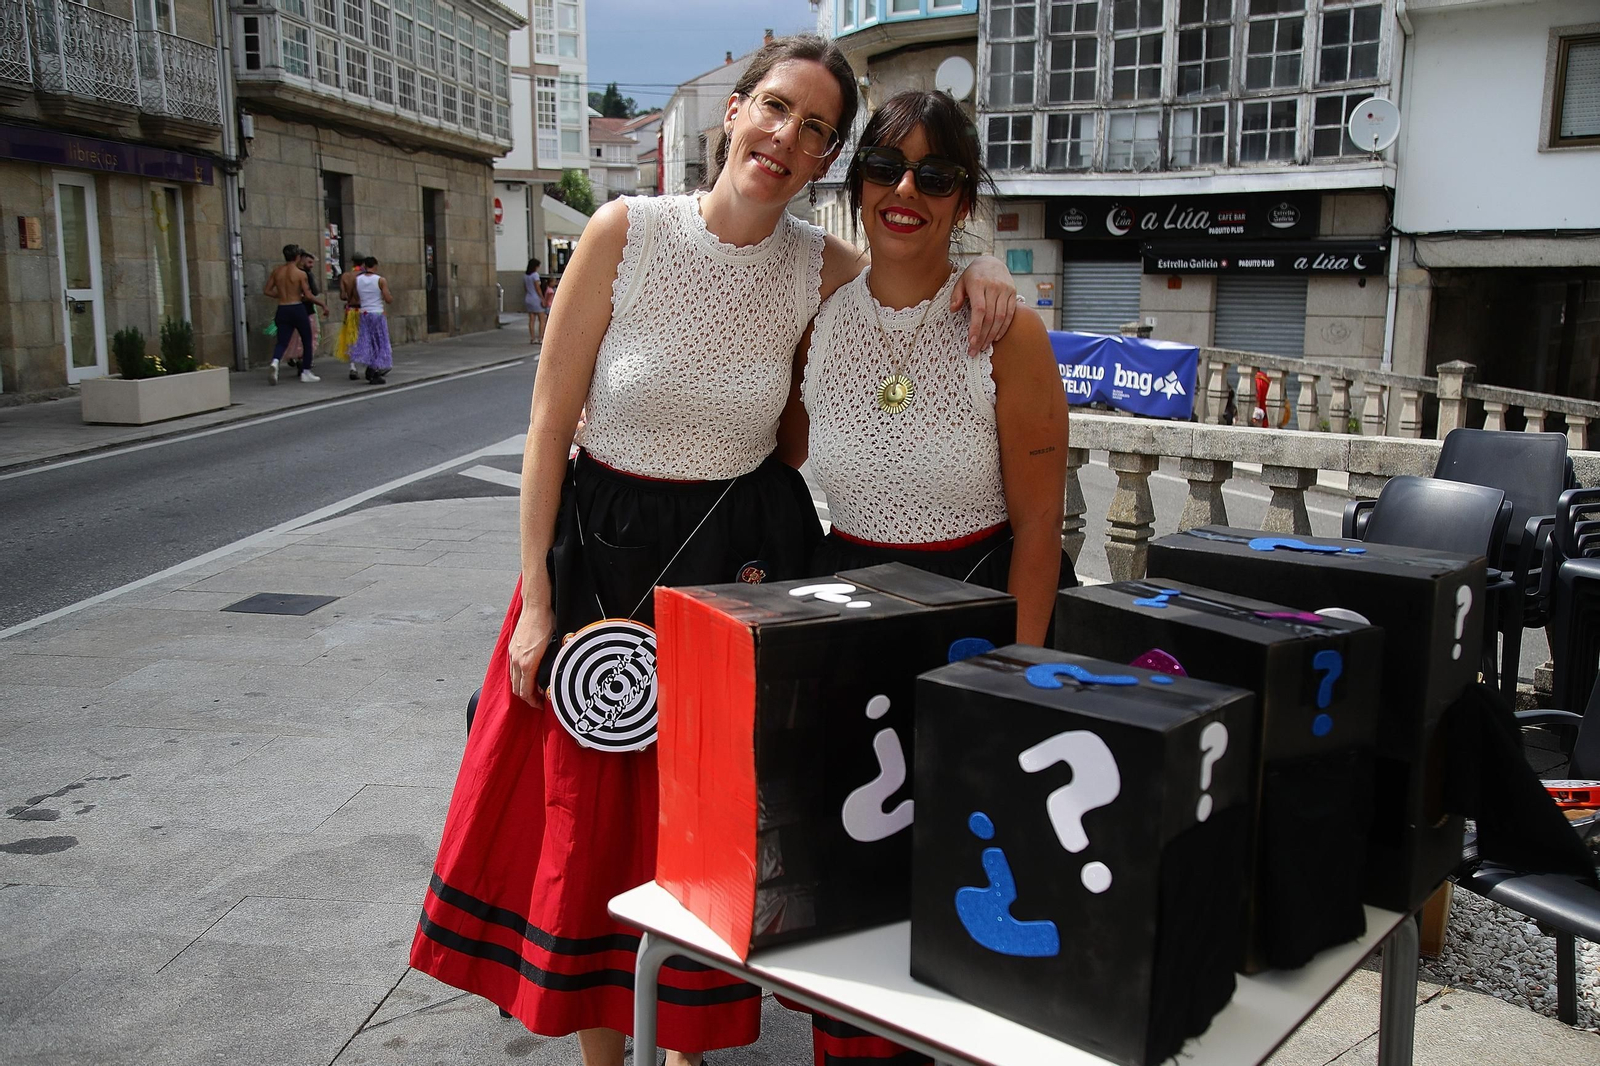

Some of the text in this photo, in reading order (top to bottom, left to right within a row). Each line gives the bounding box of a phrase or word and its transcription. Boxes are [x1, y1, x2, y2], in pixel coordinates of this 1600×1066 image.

[1141, 203, 1211, 230] a Lúa
[1208, 226, 1244, 235] PAQUITO PLUS
[1158, 259, 1275, 269] Estrella Galicia PAQUITO PLUS
[1293, 253, 1348, 270] a Lúa
[1113, 362, 1153, 397] bng
[1451, 584, 1473, 661] ?
[1311, 649, 1344, 738] ?
[1196, 721, 1229, 823] ?
[1018, 729, 1122, 894] ?
[955, 811, 1061, 958] ¿
